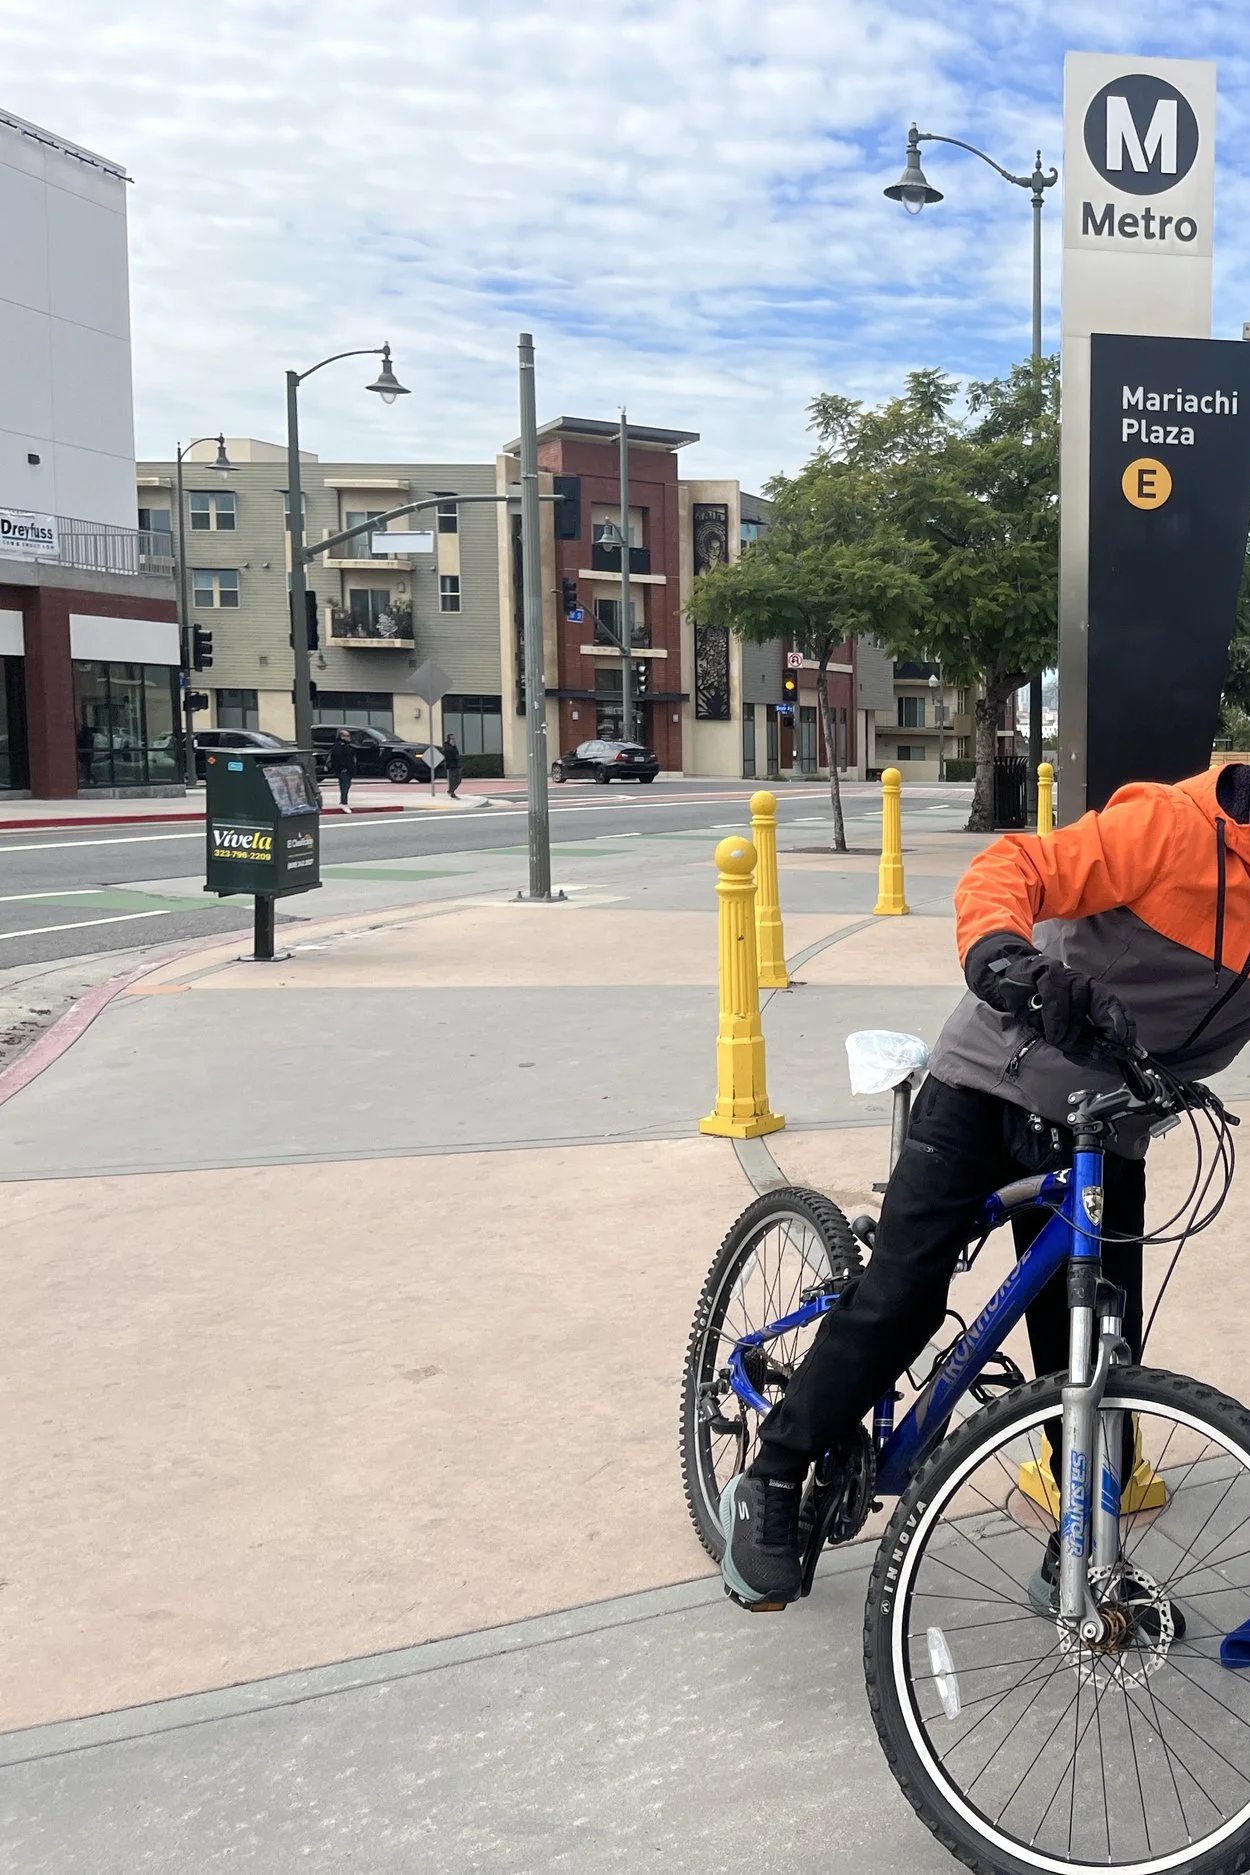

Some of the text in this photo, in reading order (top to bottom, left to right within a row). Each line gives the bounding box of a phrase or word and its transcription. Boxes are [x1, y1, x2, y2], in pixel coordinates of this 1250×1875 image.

[1106, 96, 1178, 174] M
[1081, 201, 1198, 242] Metro
[1121, 385, 1239, 416] Mariachi
[1121, 418, 1195, 446] Plaza
[1137, 468, 1157, 499] E
[0, 518, 53, 540] Dreyfuss
[214, 849, 272, 861] 323-796-2209
[883, 1500, 928, 1594] INNOVA
